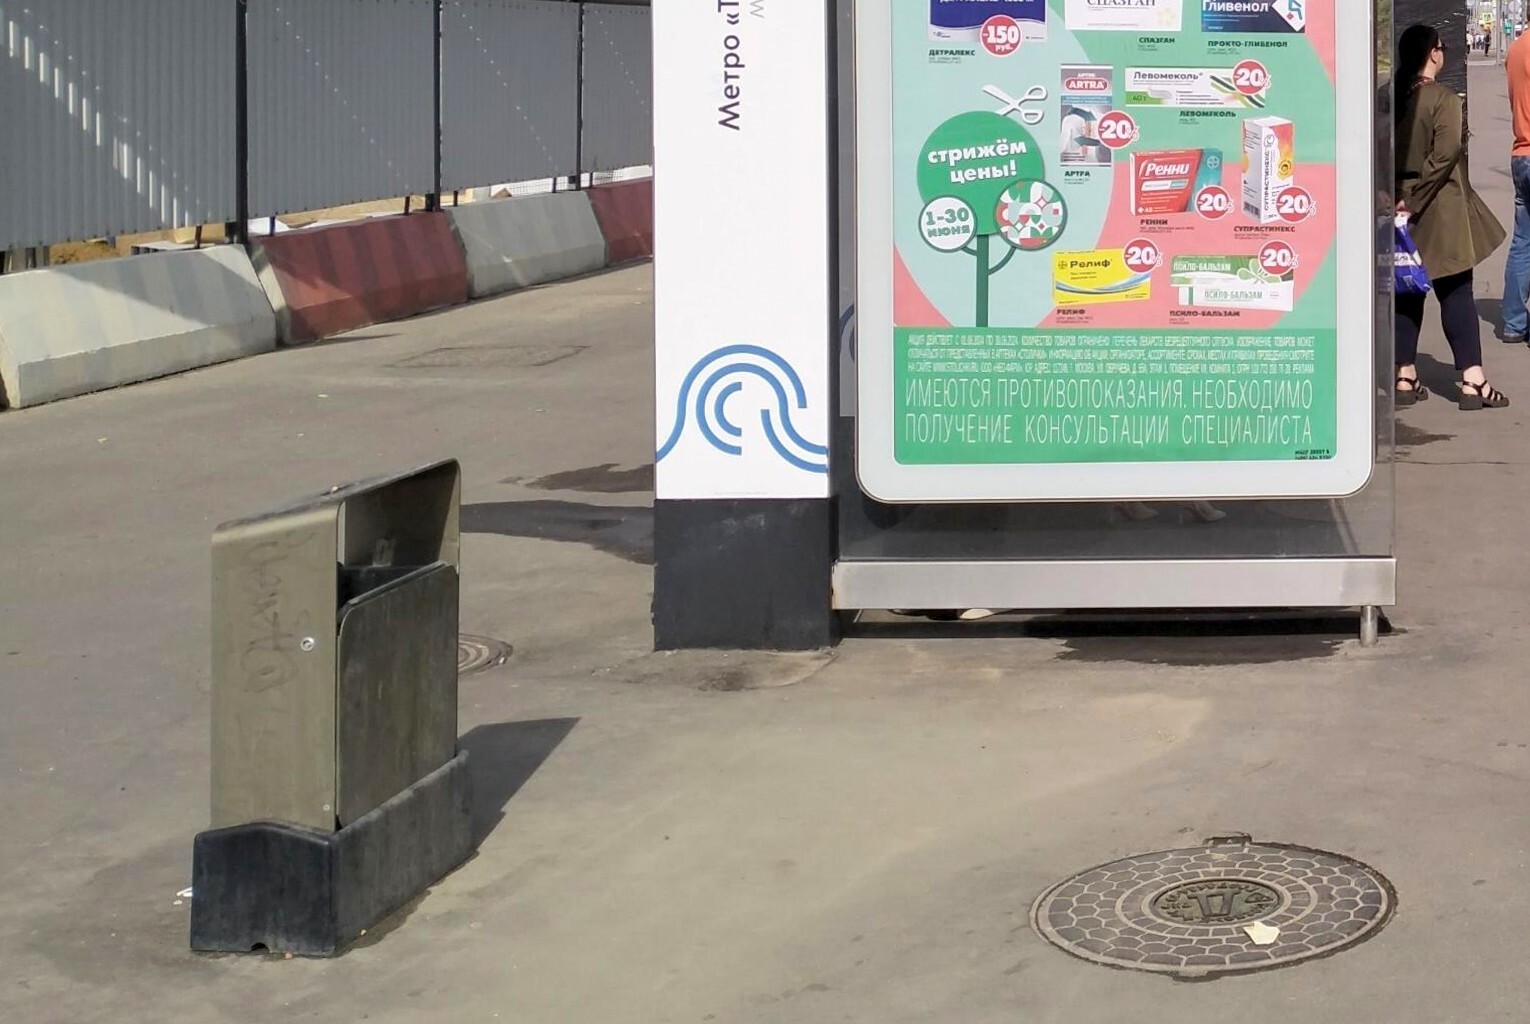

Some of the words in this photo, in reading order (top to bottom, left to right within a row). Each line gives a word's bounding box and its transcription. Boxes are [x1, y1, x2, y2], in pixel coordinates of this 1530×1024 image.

[1202, 0, 1269, 12] Гливенол
[983, 26, 1018, 44] -150
[928, 49, 976, 57] ДЕТРАЛЕКС
[718, 34, 745, 130] Метро
[1069, 80, 1105, 89] ARTRA
[928, 138, 1027, 166] стрижём
[950, 160, 1018, 184] цены!
[1145, 163, 1190, 176] Ренни
[926, 207, 970, 226] 1-30
[1070, 259, 1111, 268] Релиф
[906, 379, 991, 408] ИМЕЮТСЯ
[997, 379, 1187, 409] ПРОТИВОПОКАЗАНИЯ.
[1193, 379, 1313, 412] НЕОБХОДИМО
[906, 414, 1013, 444] ПОЛУЧЕНИЕ
[1025, 414, 1169, 448] КОНСУЛЬТАЦИИ
[1182, 415, 1312, 447] СПЕЦИАЛИСТА
